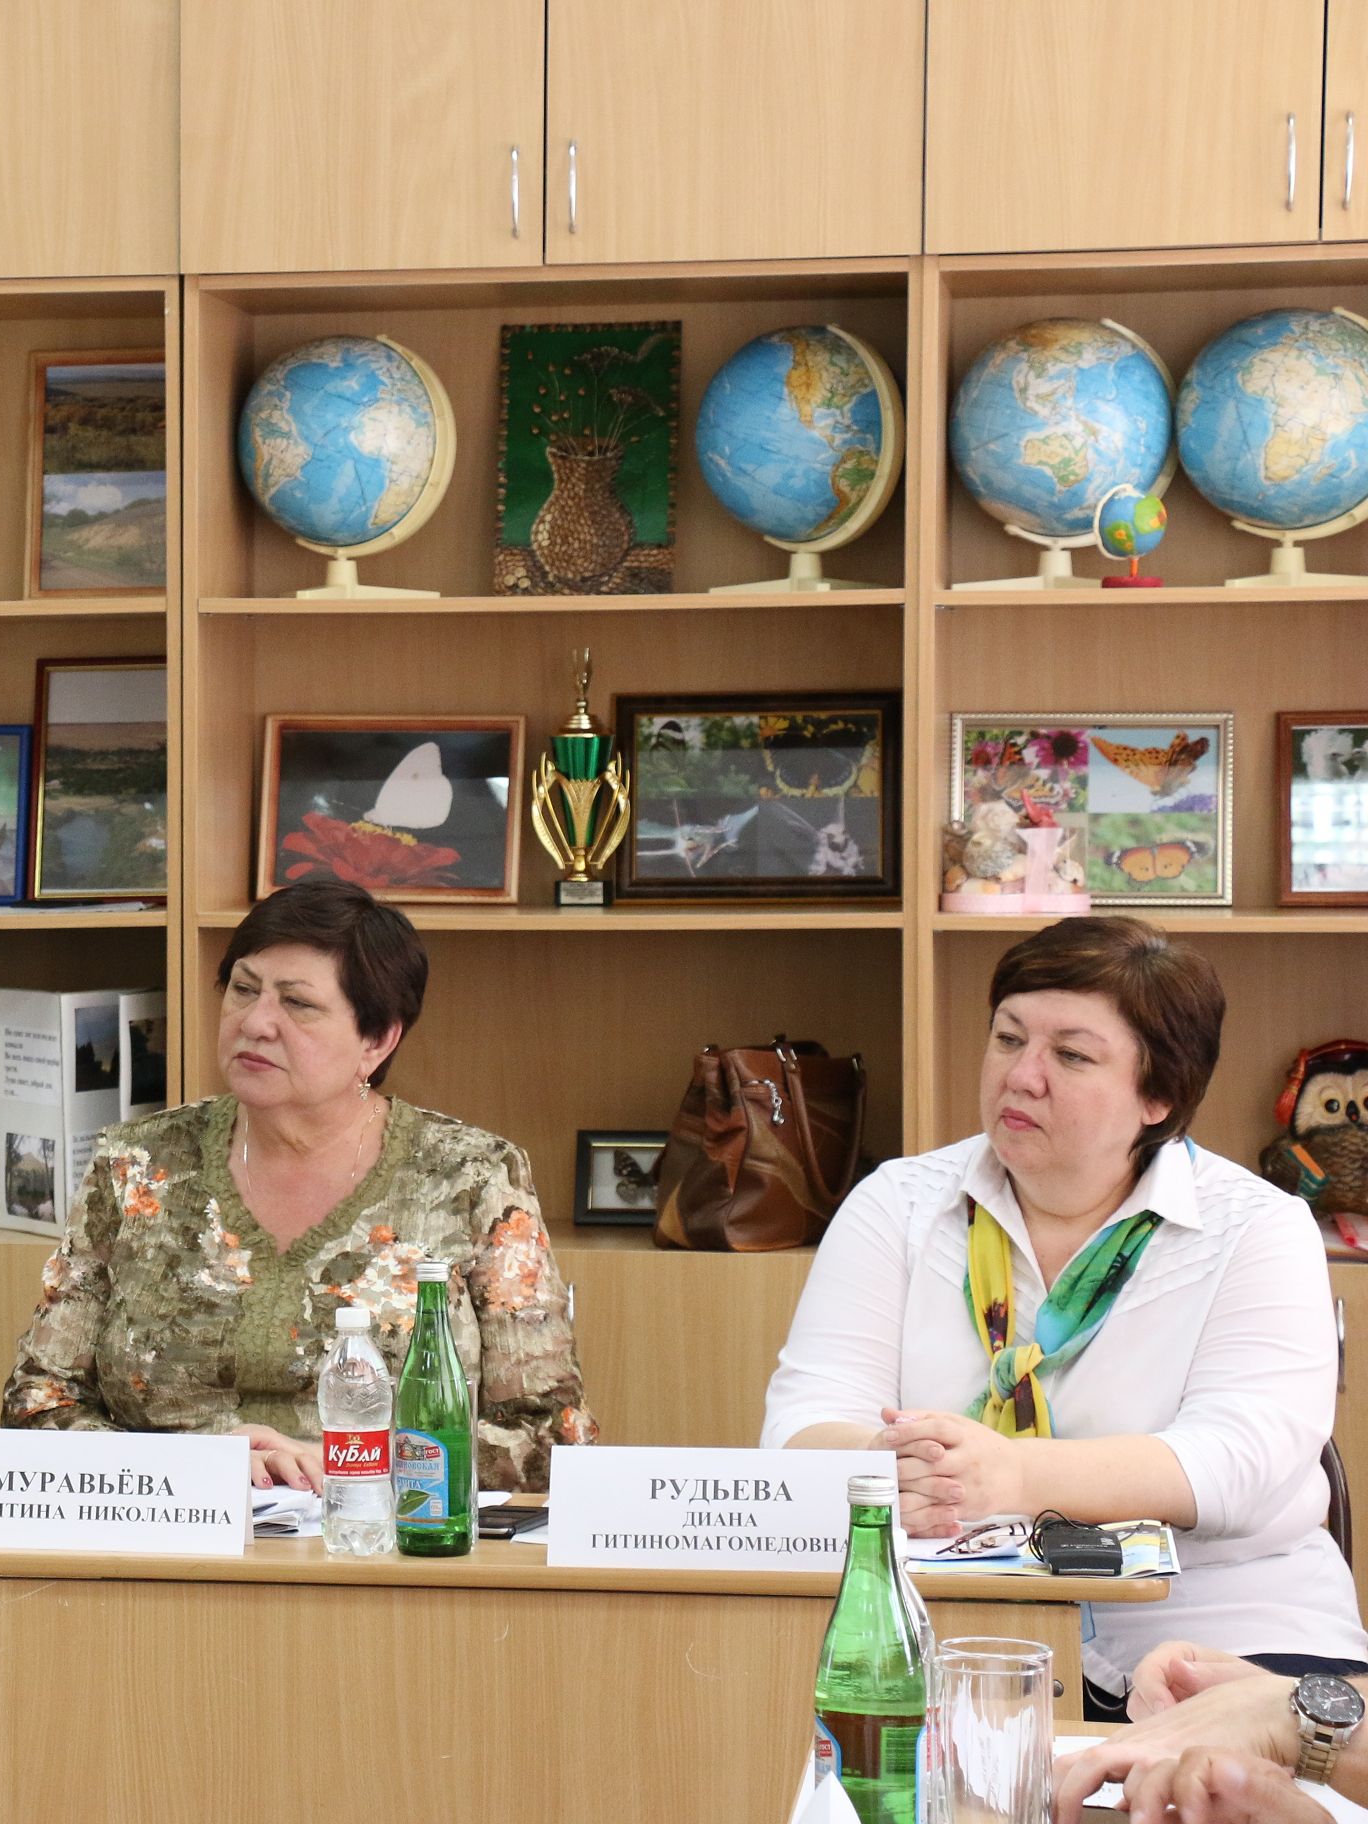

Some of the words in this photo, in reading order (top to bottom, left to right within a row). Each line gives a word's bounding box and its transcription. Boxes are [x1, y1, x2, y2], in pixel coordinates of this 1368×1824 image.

[650, 1478, 793, 1505] РУДЬЕВА
[78, 1505, 232, 1525] НИКОЛАЕВНА
[682, 1511, 758, 1529] ДИАНА
[592, 1532, 849, 1555] ГИТИНОМАГОМЕДОВНА
